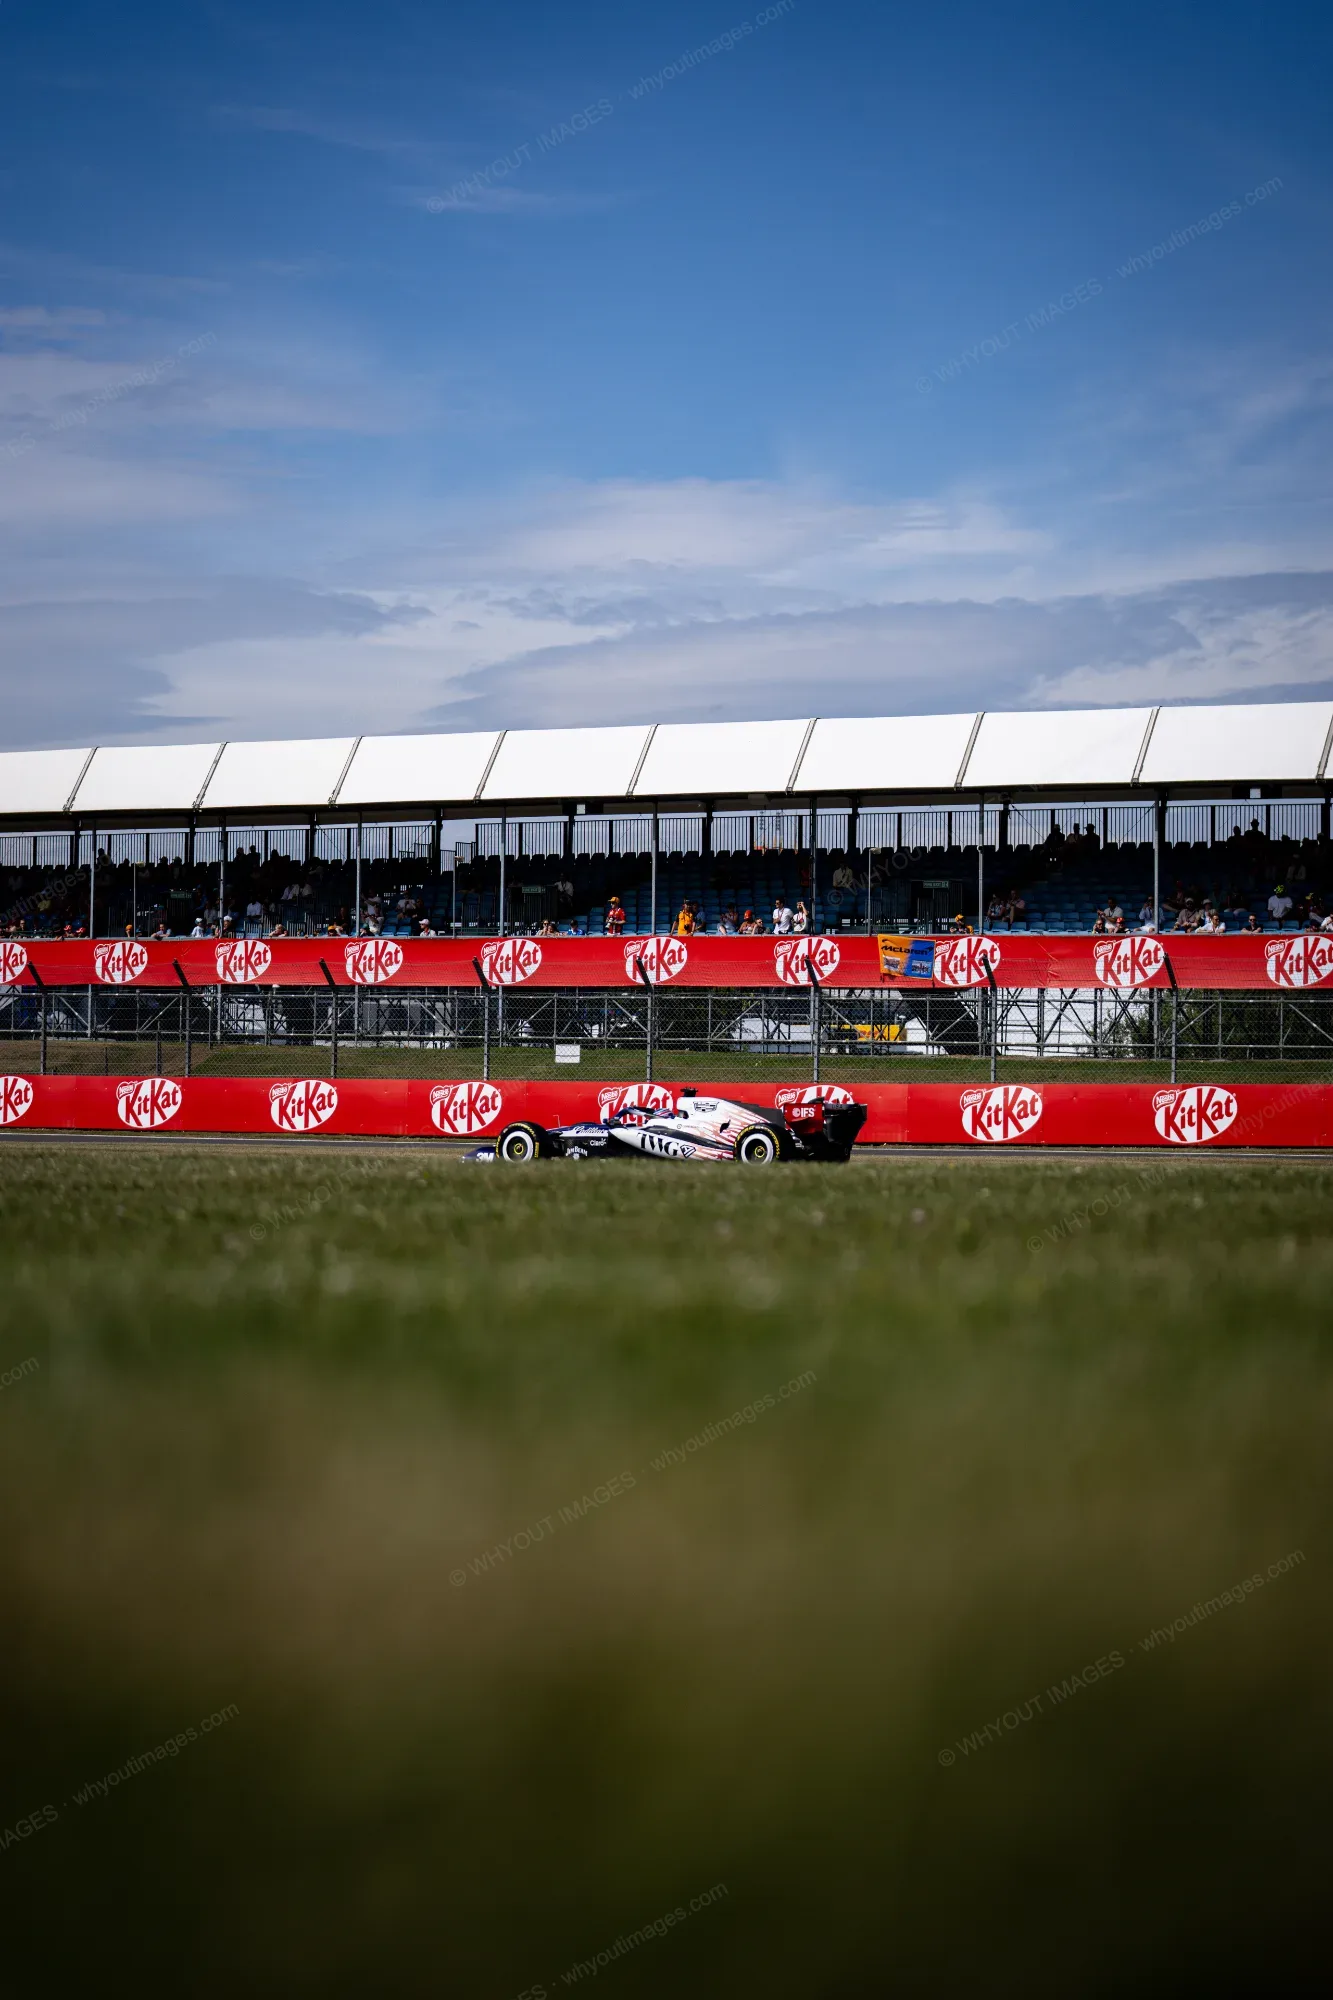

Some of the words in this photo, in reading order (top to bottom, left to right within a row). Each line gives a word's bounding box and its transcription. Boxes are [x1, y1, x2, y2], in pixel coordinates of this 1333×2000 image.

[0, 943, 25, 982] Kat
[101, 942, 146, 982] KitKat
[222, 941, 269, 982] KitKat
[352, 940, 401, 983] KitKat
[488, 940, 539, 983] KitKat
[632, 938, 685, 984] KitKat
[783, 938, 837, 984] KitKat
[881, 944, 930, 956] McLaren
[941, 938, 997, 985] KitKat
[1102, 937, 1162, 986] KitKat
[0, 1077, 31, 1122] Kat
[125, 1079, 179, 1127] KitKat
[278, 1081, 335, 1130] KitKat
[439, 1083, 500, 1133] KitKat
[801, 1107, 815, 1118] IFS
[971, 1087, 1040, 1140] KitKat
[1164, 1088, 1234, 1141] KitKat
[476, 1152, 494, 1162] 3M
[637, 1132, 680, 1156] TWG
